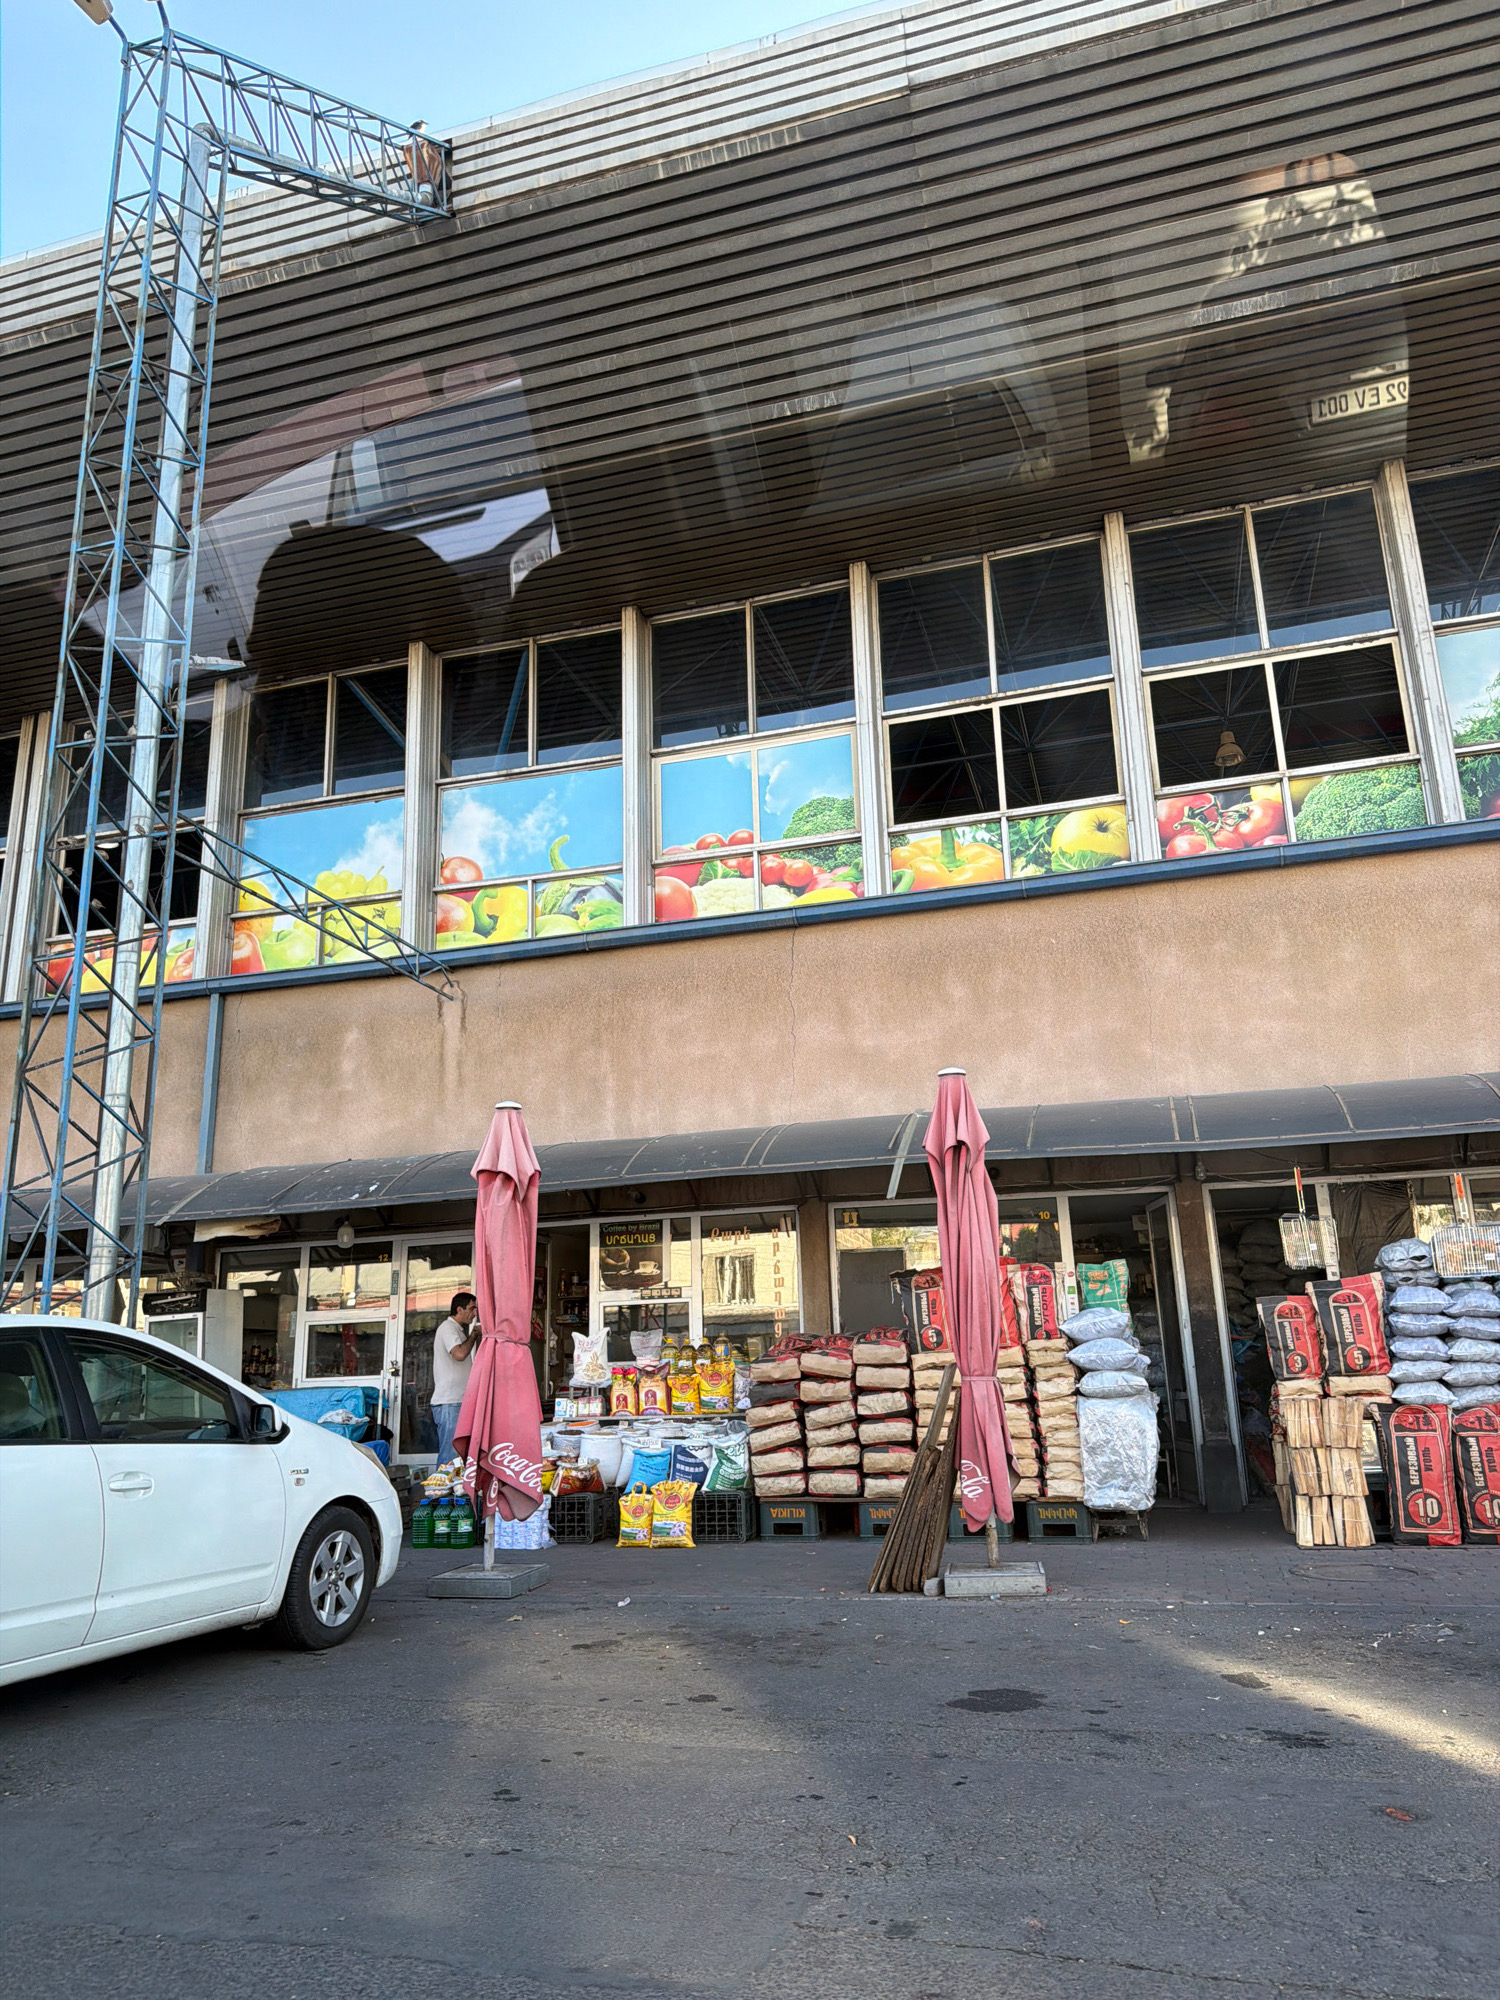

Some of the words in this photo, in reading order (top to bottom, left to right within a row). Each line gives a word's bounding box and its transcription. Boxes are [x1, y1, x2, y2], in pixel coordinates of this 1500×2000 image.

[1038, 1211, 1050, 1220] 10
[928, 1329, 938, 1343] 5
[1293, 1355, 1303, 1368] 3
[1353, 1350, 1364, 1365] 5
[769, 1507, 806, 1518] KILIKIA
[1414, 1497, 1439, 1518] 10
